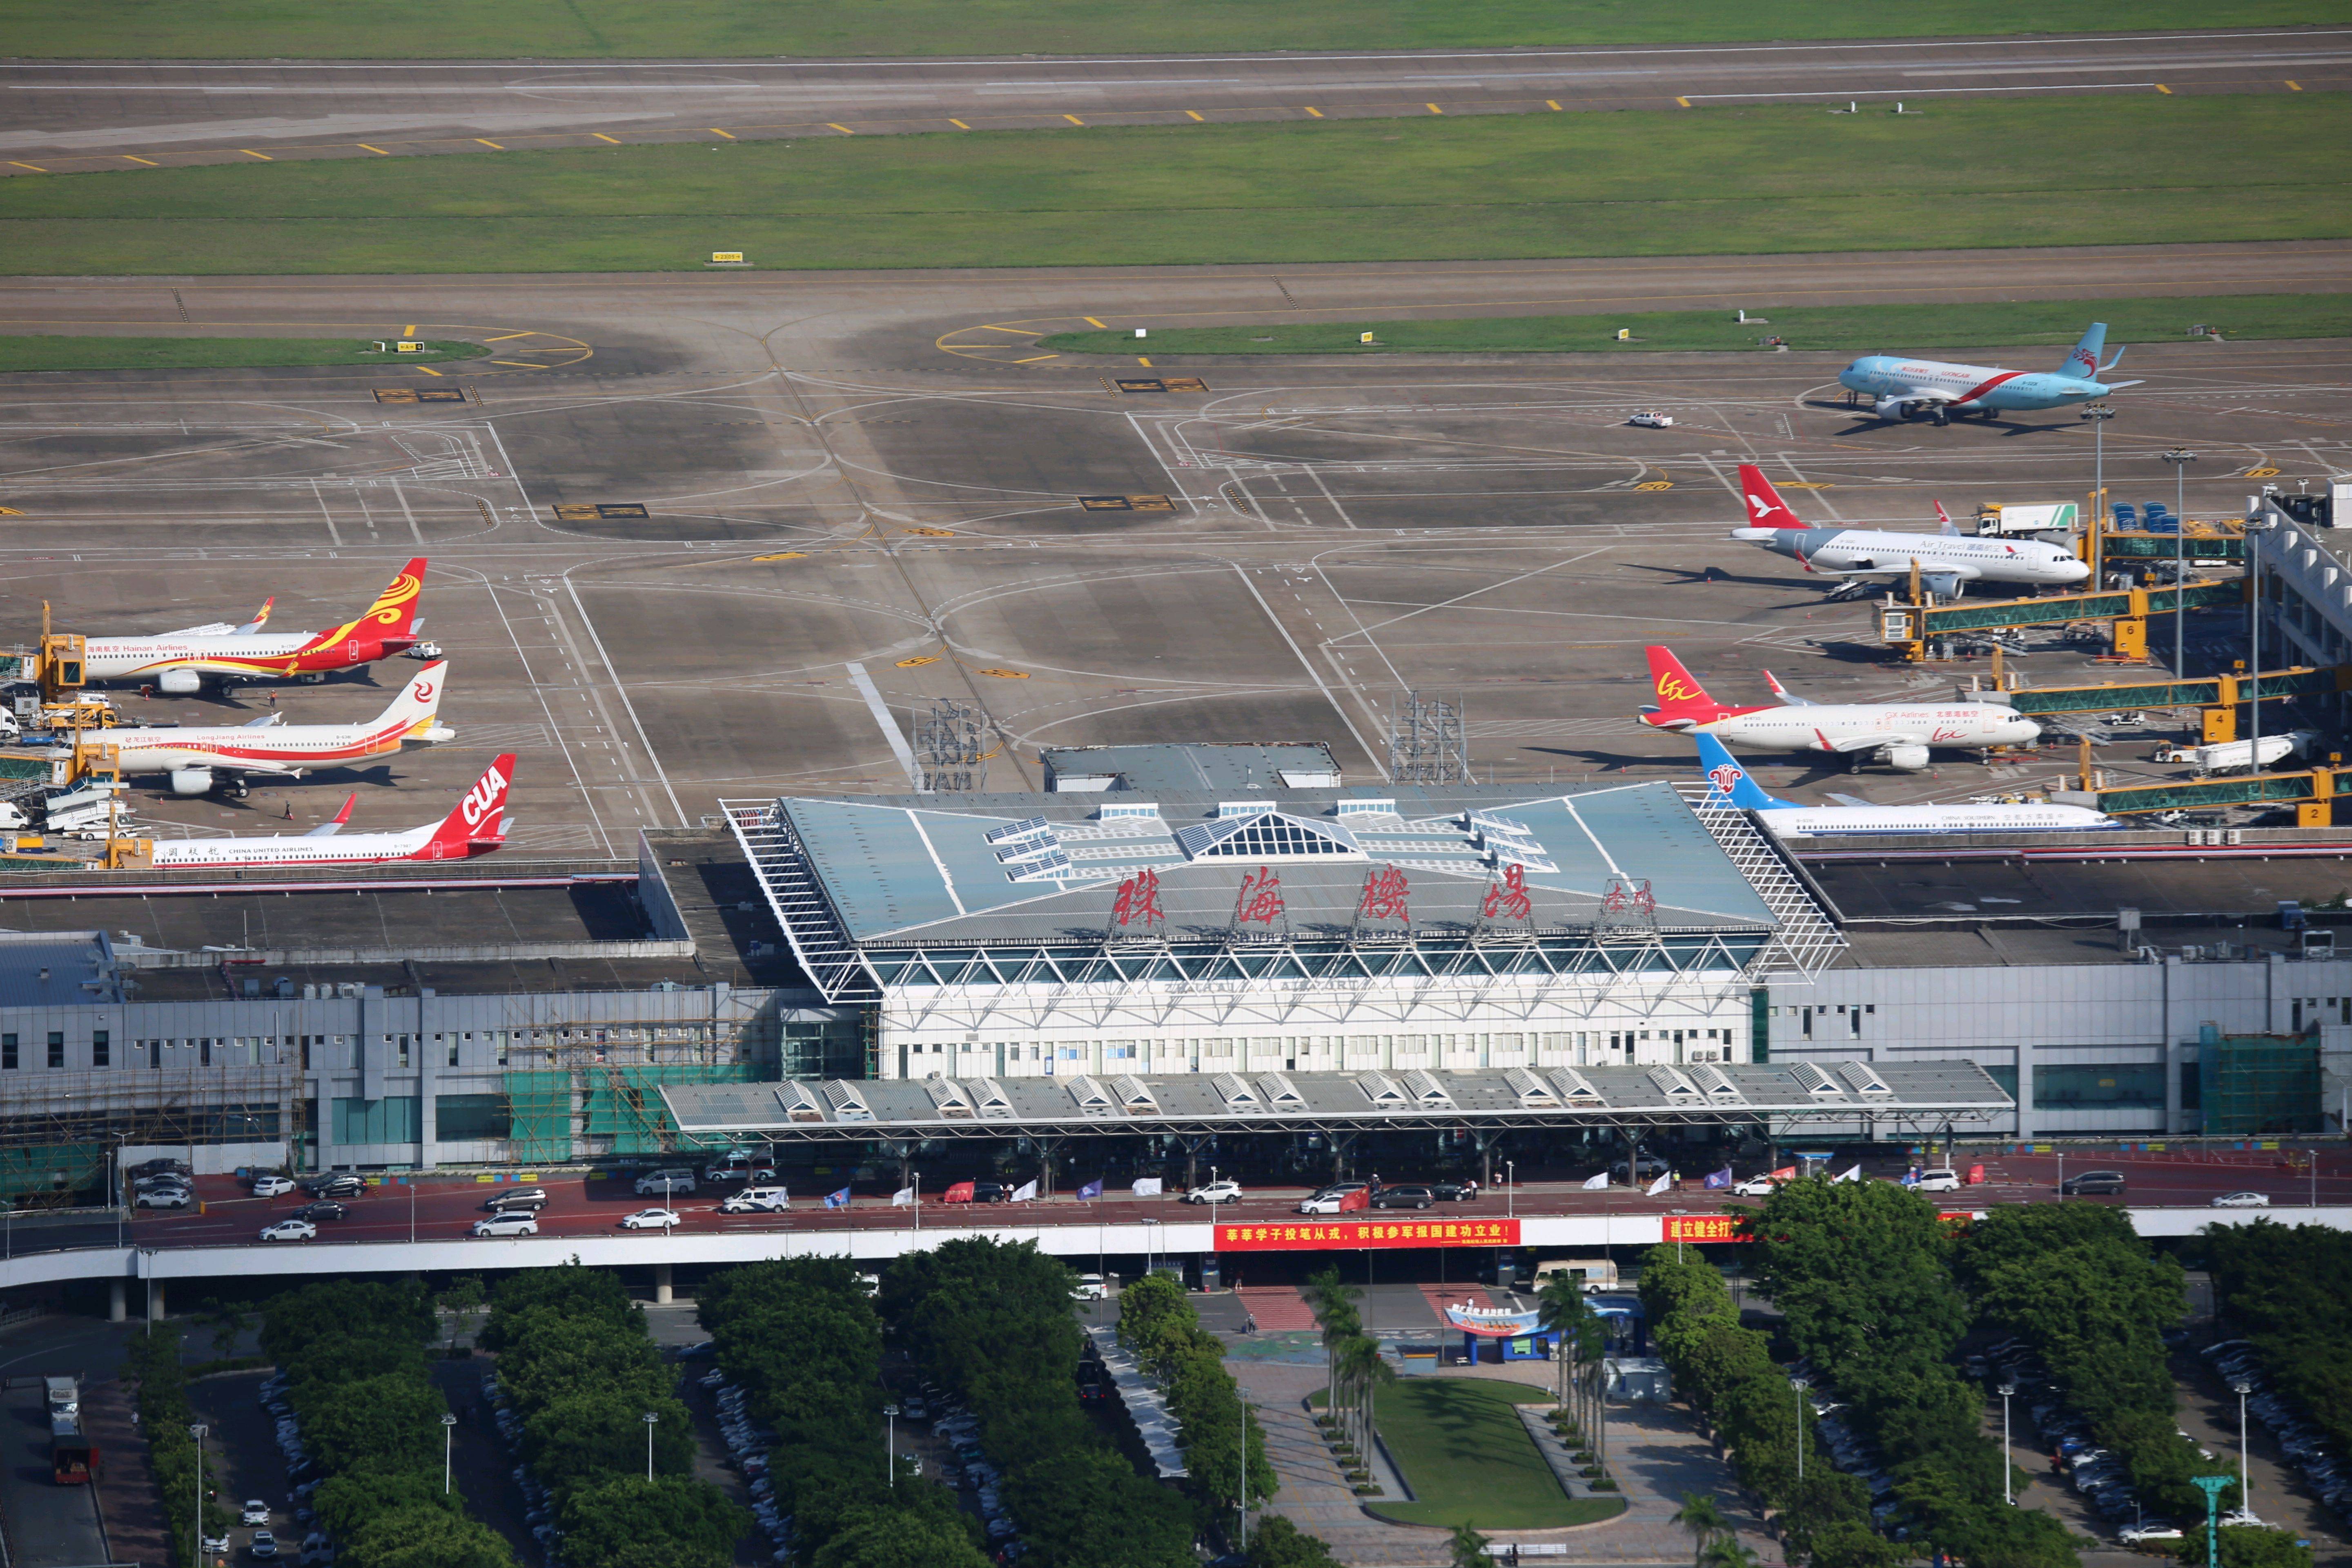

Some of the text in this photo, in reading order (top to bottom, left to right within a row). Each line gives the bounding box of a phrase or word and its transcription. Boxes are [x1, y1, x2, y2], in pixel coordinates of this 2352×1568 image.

[1939, 541, 1965, 550] Travel
[2127, 625, 2134, 635] 6
[2216, 715, 2224, 723] 4
[462, 765, 508, 826] CUA
[2311, 809, 2319, 818] 2
